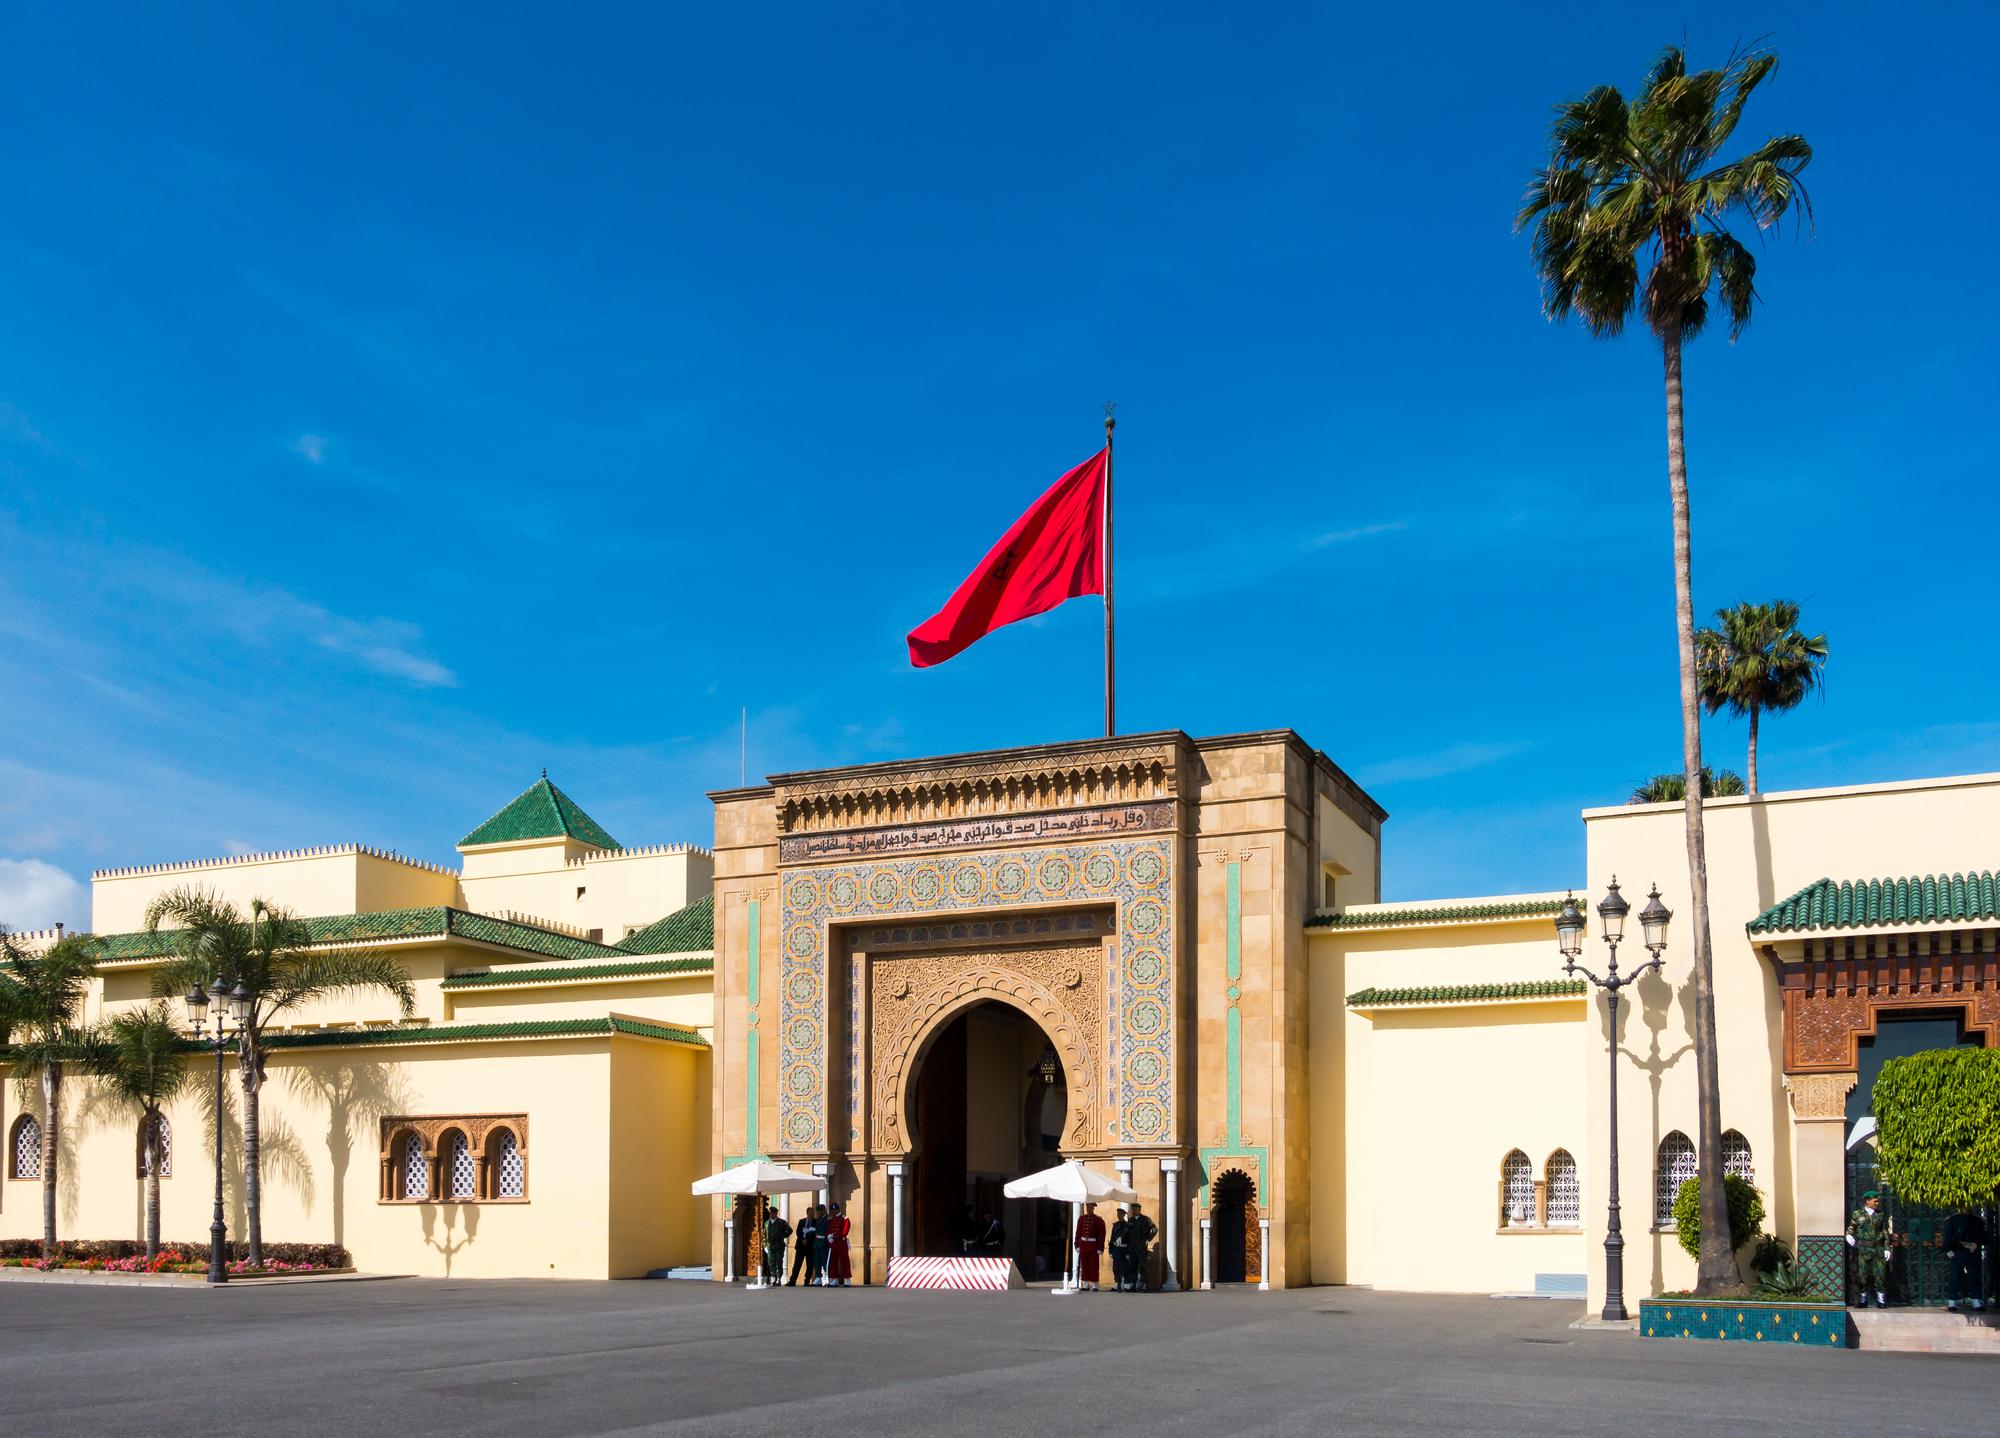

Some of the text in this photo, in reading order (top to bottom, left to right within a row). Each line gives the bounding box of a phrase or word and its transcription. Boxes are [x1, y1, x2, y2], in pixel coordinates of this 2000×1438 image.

[1002, 821, 1036, 835] صدق
[1035, 817, 1068, 836] مدخل
[1120, 810, 1144, 828] وقل
[910, 830, 938, 844] صدق
[937, 826, 962, 845] مخرج
